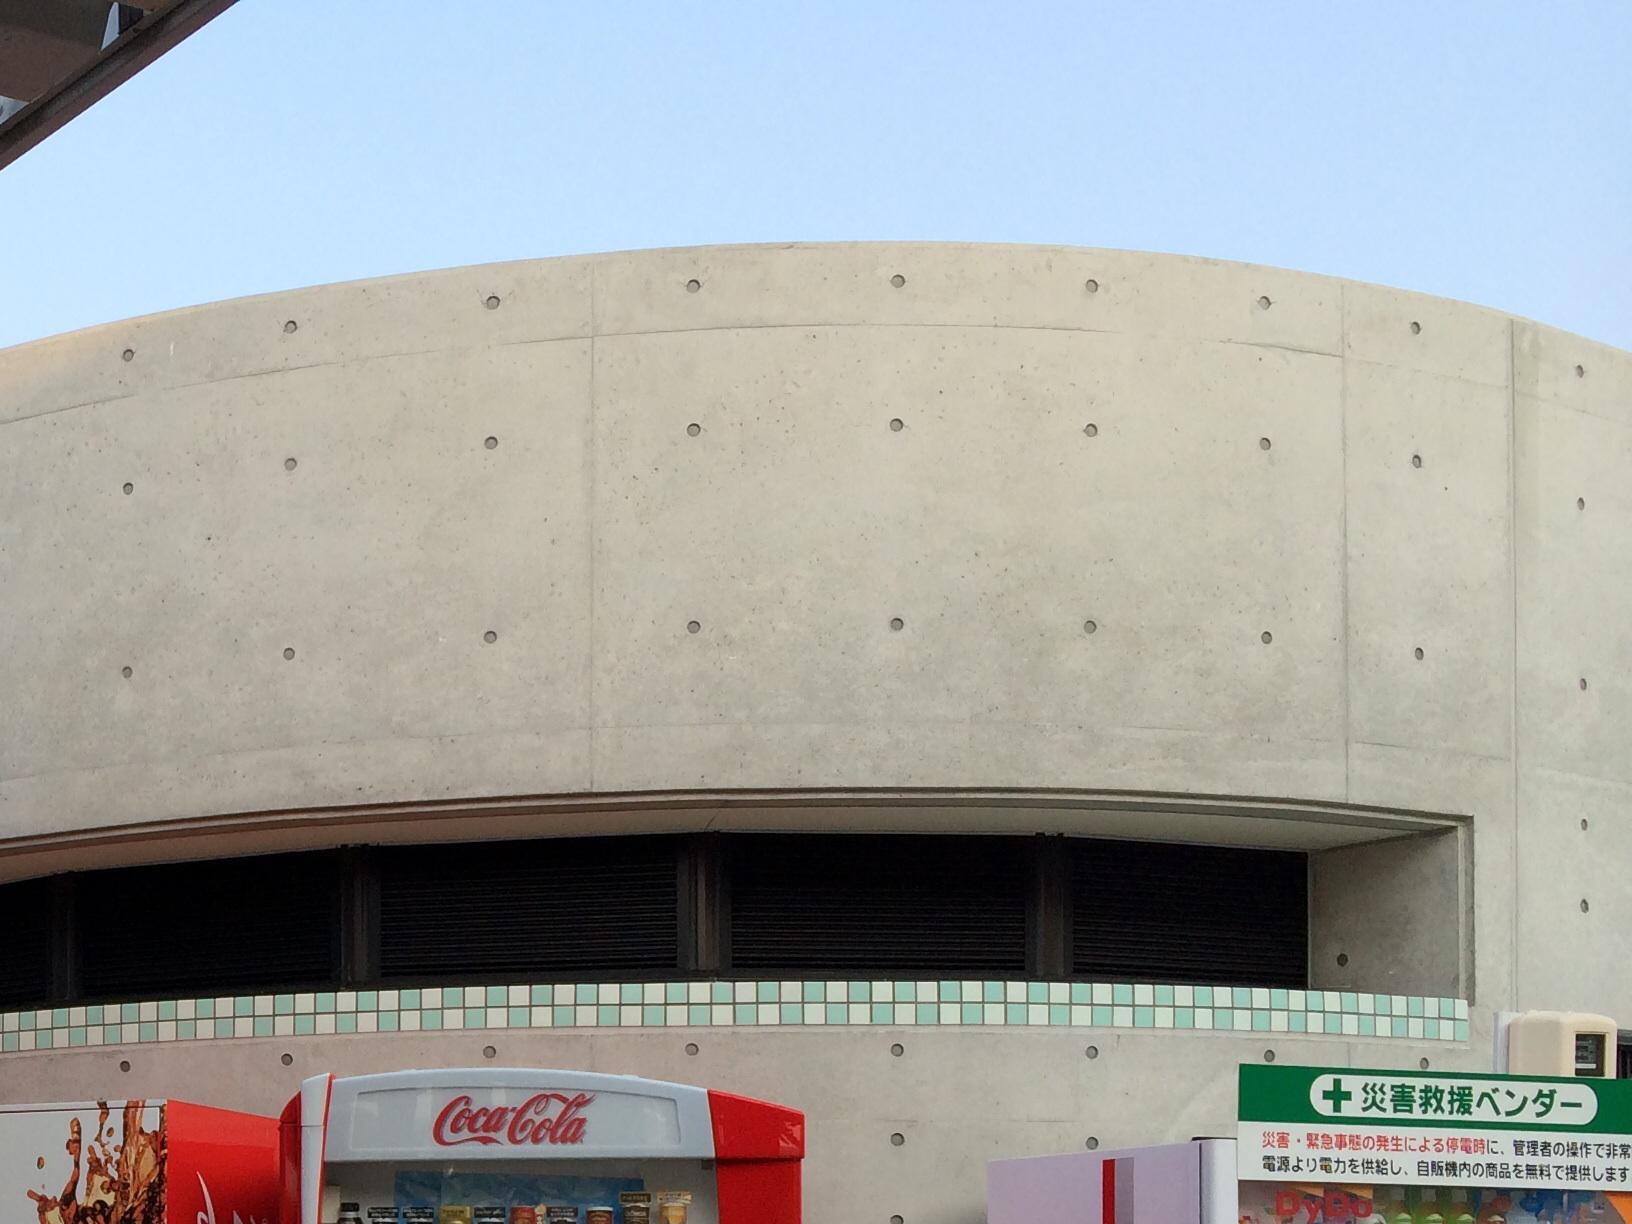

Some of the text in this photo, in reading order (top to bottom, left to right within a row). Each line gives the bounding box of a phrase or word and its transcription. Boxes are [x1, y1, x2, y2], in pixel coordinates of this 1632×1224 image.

[433, 1092, 597, 1146] Coca-Cola
[1361, 1081, 1582, 1119] 災害救援ベンダー
[1276, 1191, 1373, 1224] DyDo
